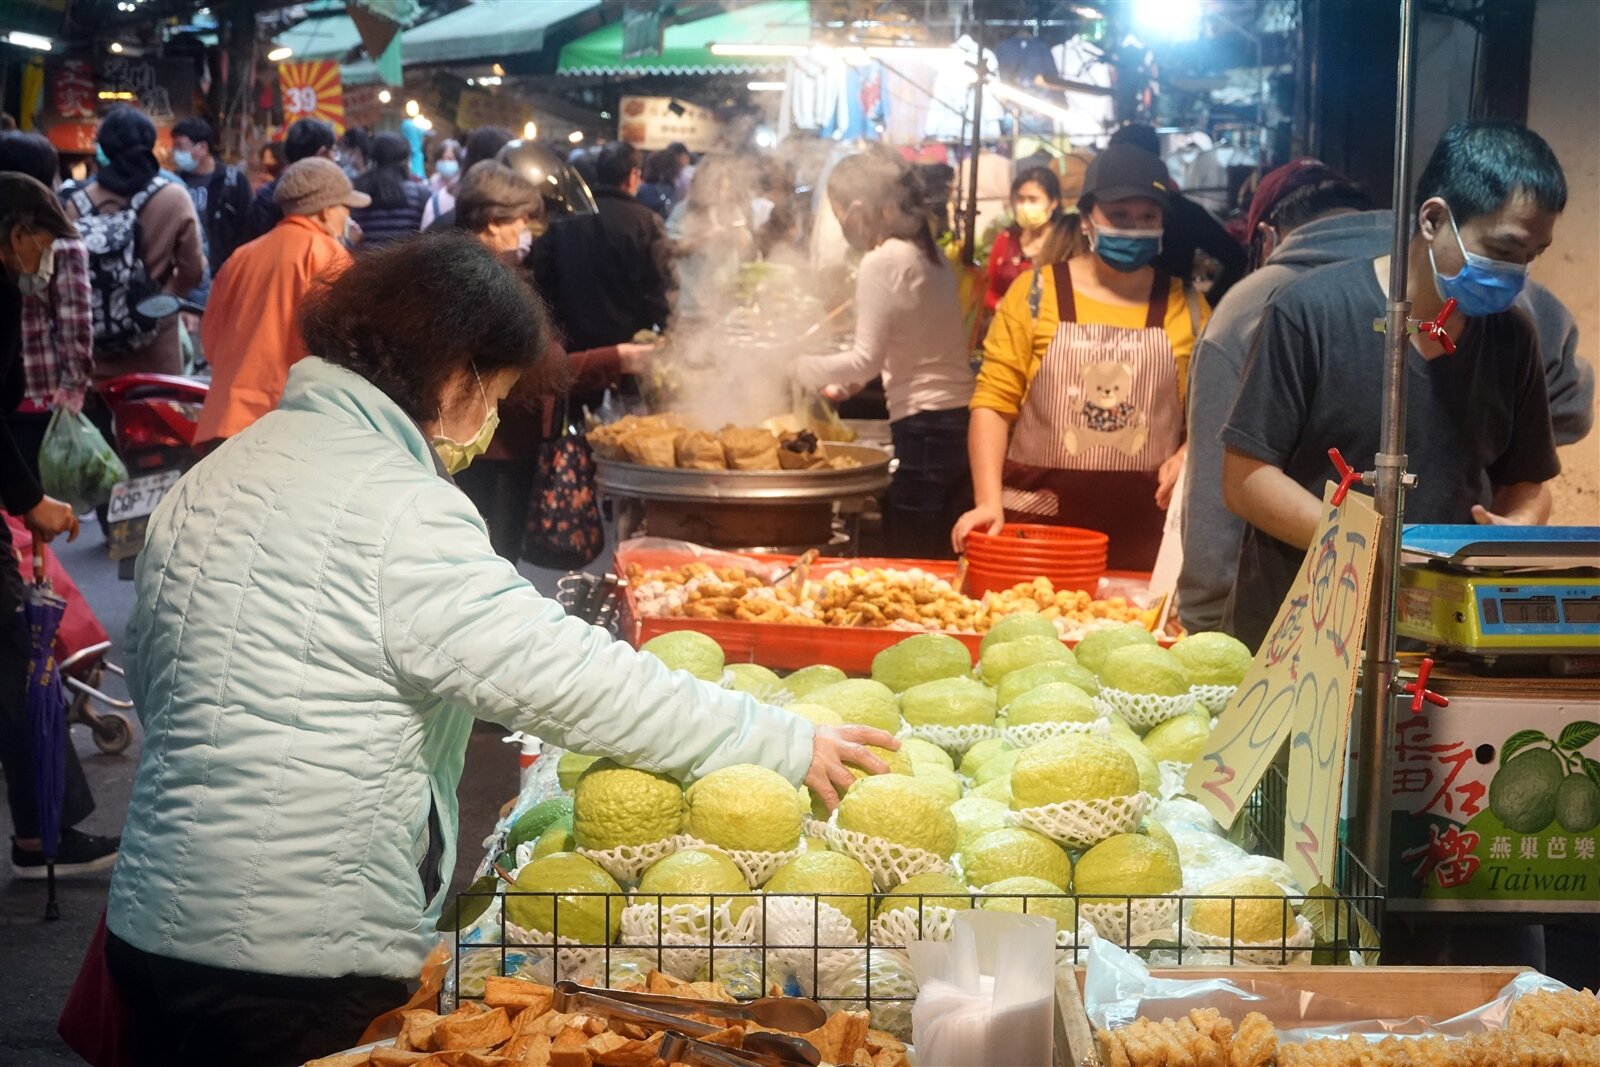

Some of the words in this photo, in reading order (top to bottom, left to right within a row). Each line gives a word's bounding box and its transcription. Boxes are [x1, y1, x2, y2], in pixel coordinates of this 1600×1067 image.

[286, 85, 317, 115] 39
[1489, 836, 1597, 860] 燕巢芭樂
[1488, 866, 1587, 892] Taiwan
